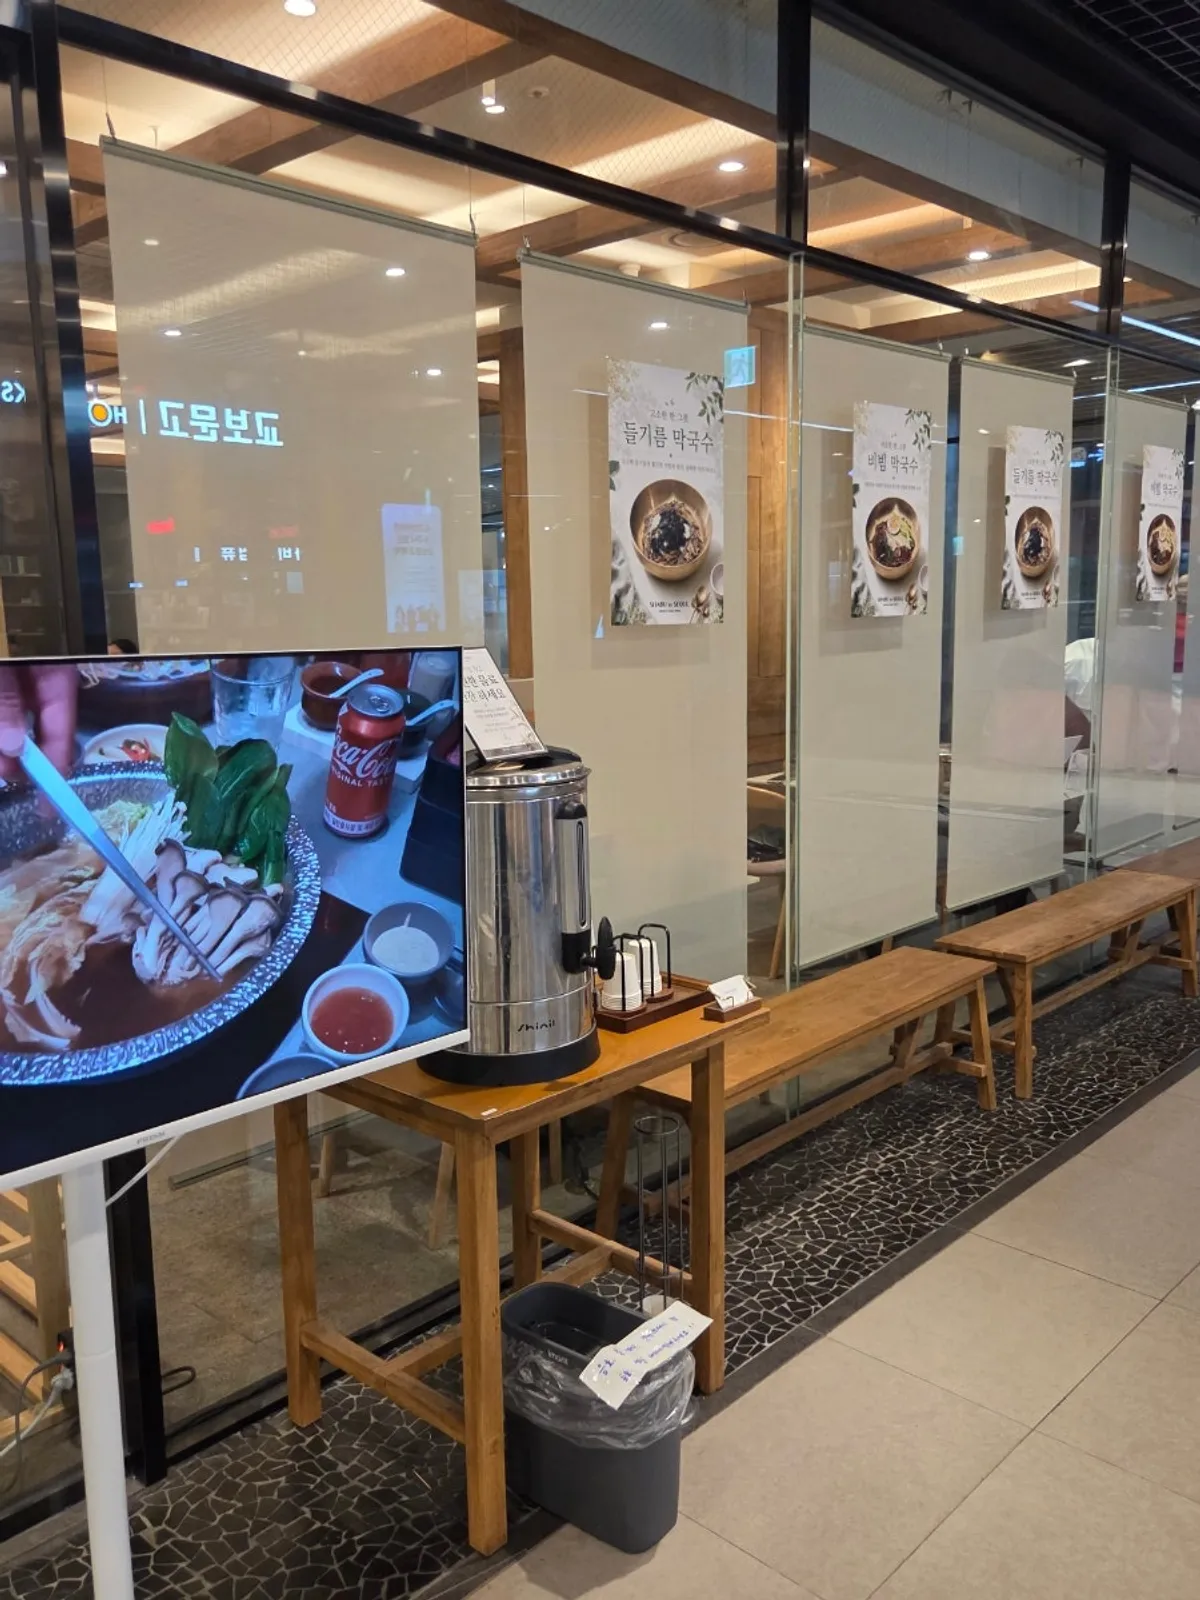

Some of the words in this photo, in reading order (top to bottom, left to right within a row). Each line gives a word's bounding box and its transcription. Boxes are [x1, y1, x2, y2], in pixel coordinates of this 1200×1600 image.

[624, 421, 667, 449] 들기름
[672, 427, 714, 454] 막국수
[868, 451, 886, 472] 비빔
[891, 455, 918, 476] 막국수
